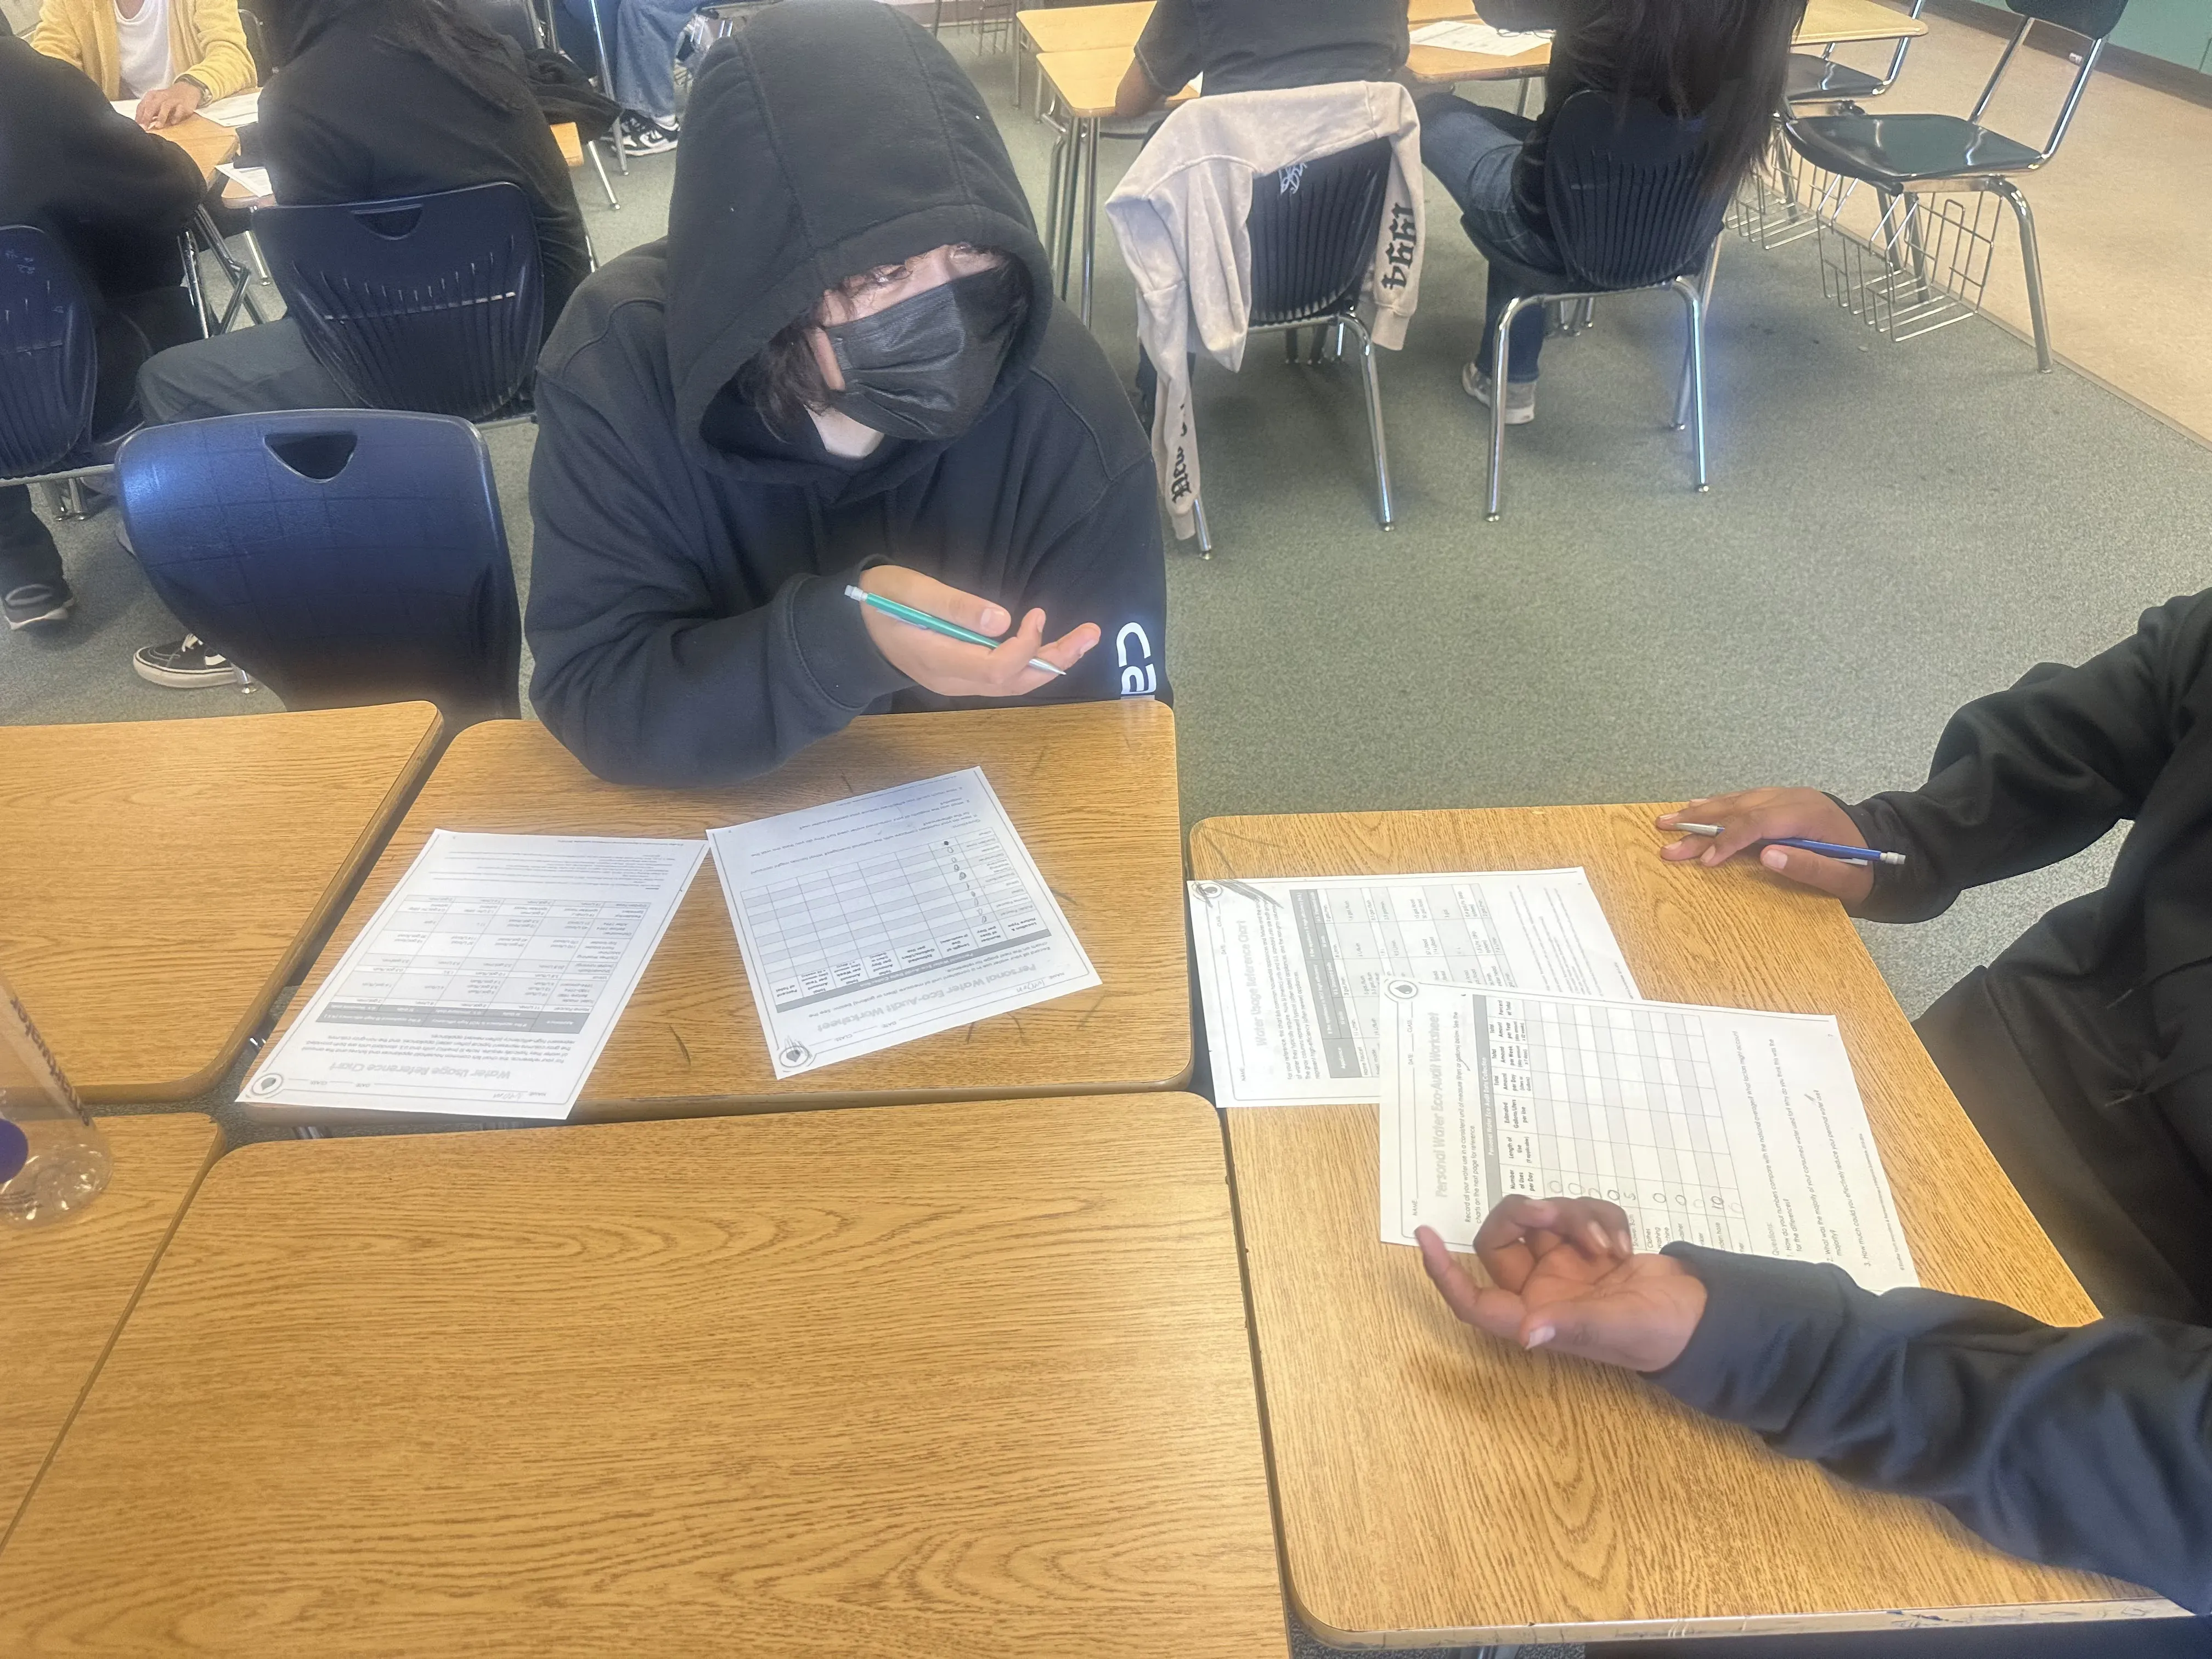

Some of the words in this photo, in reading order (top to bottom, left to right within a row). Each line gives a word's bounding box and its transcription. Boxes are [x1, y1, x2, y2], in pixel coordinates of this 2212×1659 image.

[1235, 920, 1250, 942] Chart
[985, 963, 1036, 983] Personal
[1239, 944, 1257, 986] Reference
[945, 978, 985, 995] Water
[885, 989, 945, 1012] Eco-Audit
[1246, 988, 1265, 1015] Usage
[816, 1006, 884, 1032] Worksheet
[1251, 1017, 1267, 1046] Water
[1427, 1012, 1441, 1062] Worksheet
[1732, 1031, 1741, 1050] account
[1737, 1051, 1746, 1064] might
[1741, 1065, 1749, 1081] factors
[1429, 1064, 1443, 1111] Eco-Audit
[1745, 1082, 1753, 1094] What
[1813, 1090, 1821, 1100] use?
[1748, 1096, 1760, 1120] averages?
[1784, 1096, 1792, 1106] Why
[1816, 1101, 1826, 1115] water
[1432, 1113, 1446, 1147] Water
[1754, 1121, 1764, 1142] national
[1789, 1117, 1797, 1128] used
[1821, 1115, 1833, 1137] personal
[1792, 1130, 1801, 1144] water
[1829, 1138, 1837, 1149] your
[1797, 1146, 1809, 1173] consumed
[1831, 1150, 1842, 1170] reduce
[1433, 1149, 1448, 1198] Personal
[1767, 1165, 1778, 1189] compare
[1805, 1174, 1814, 1186] your
[1837, 1170, 1851, 1197] effectively
[1771, 1190, 1782, 1214] numbers
[1810, 1194, 1821, 1214] majority
[1846, 1198, 1854, 1208] you
[1779, 1215, 1787, 1227] your
[1783, 1198, 1797, 1231] differences?
[1848, 1210, 1858, 1226] could
[1644, 1228, 1654, 1248] Clothes
[1714, 1222, 1723, 1234] hose
[1854, 1227, 1864, 1244] much
[1765, 1222, 1780, 1256] Questions:
[1783, 1238, 1792, 1250] How
[1822, 1239, 1831, 1254] What
[1829, 1229, 1843, 1256] majority?
[1859, 1245, 1868, 1259] How
